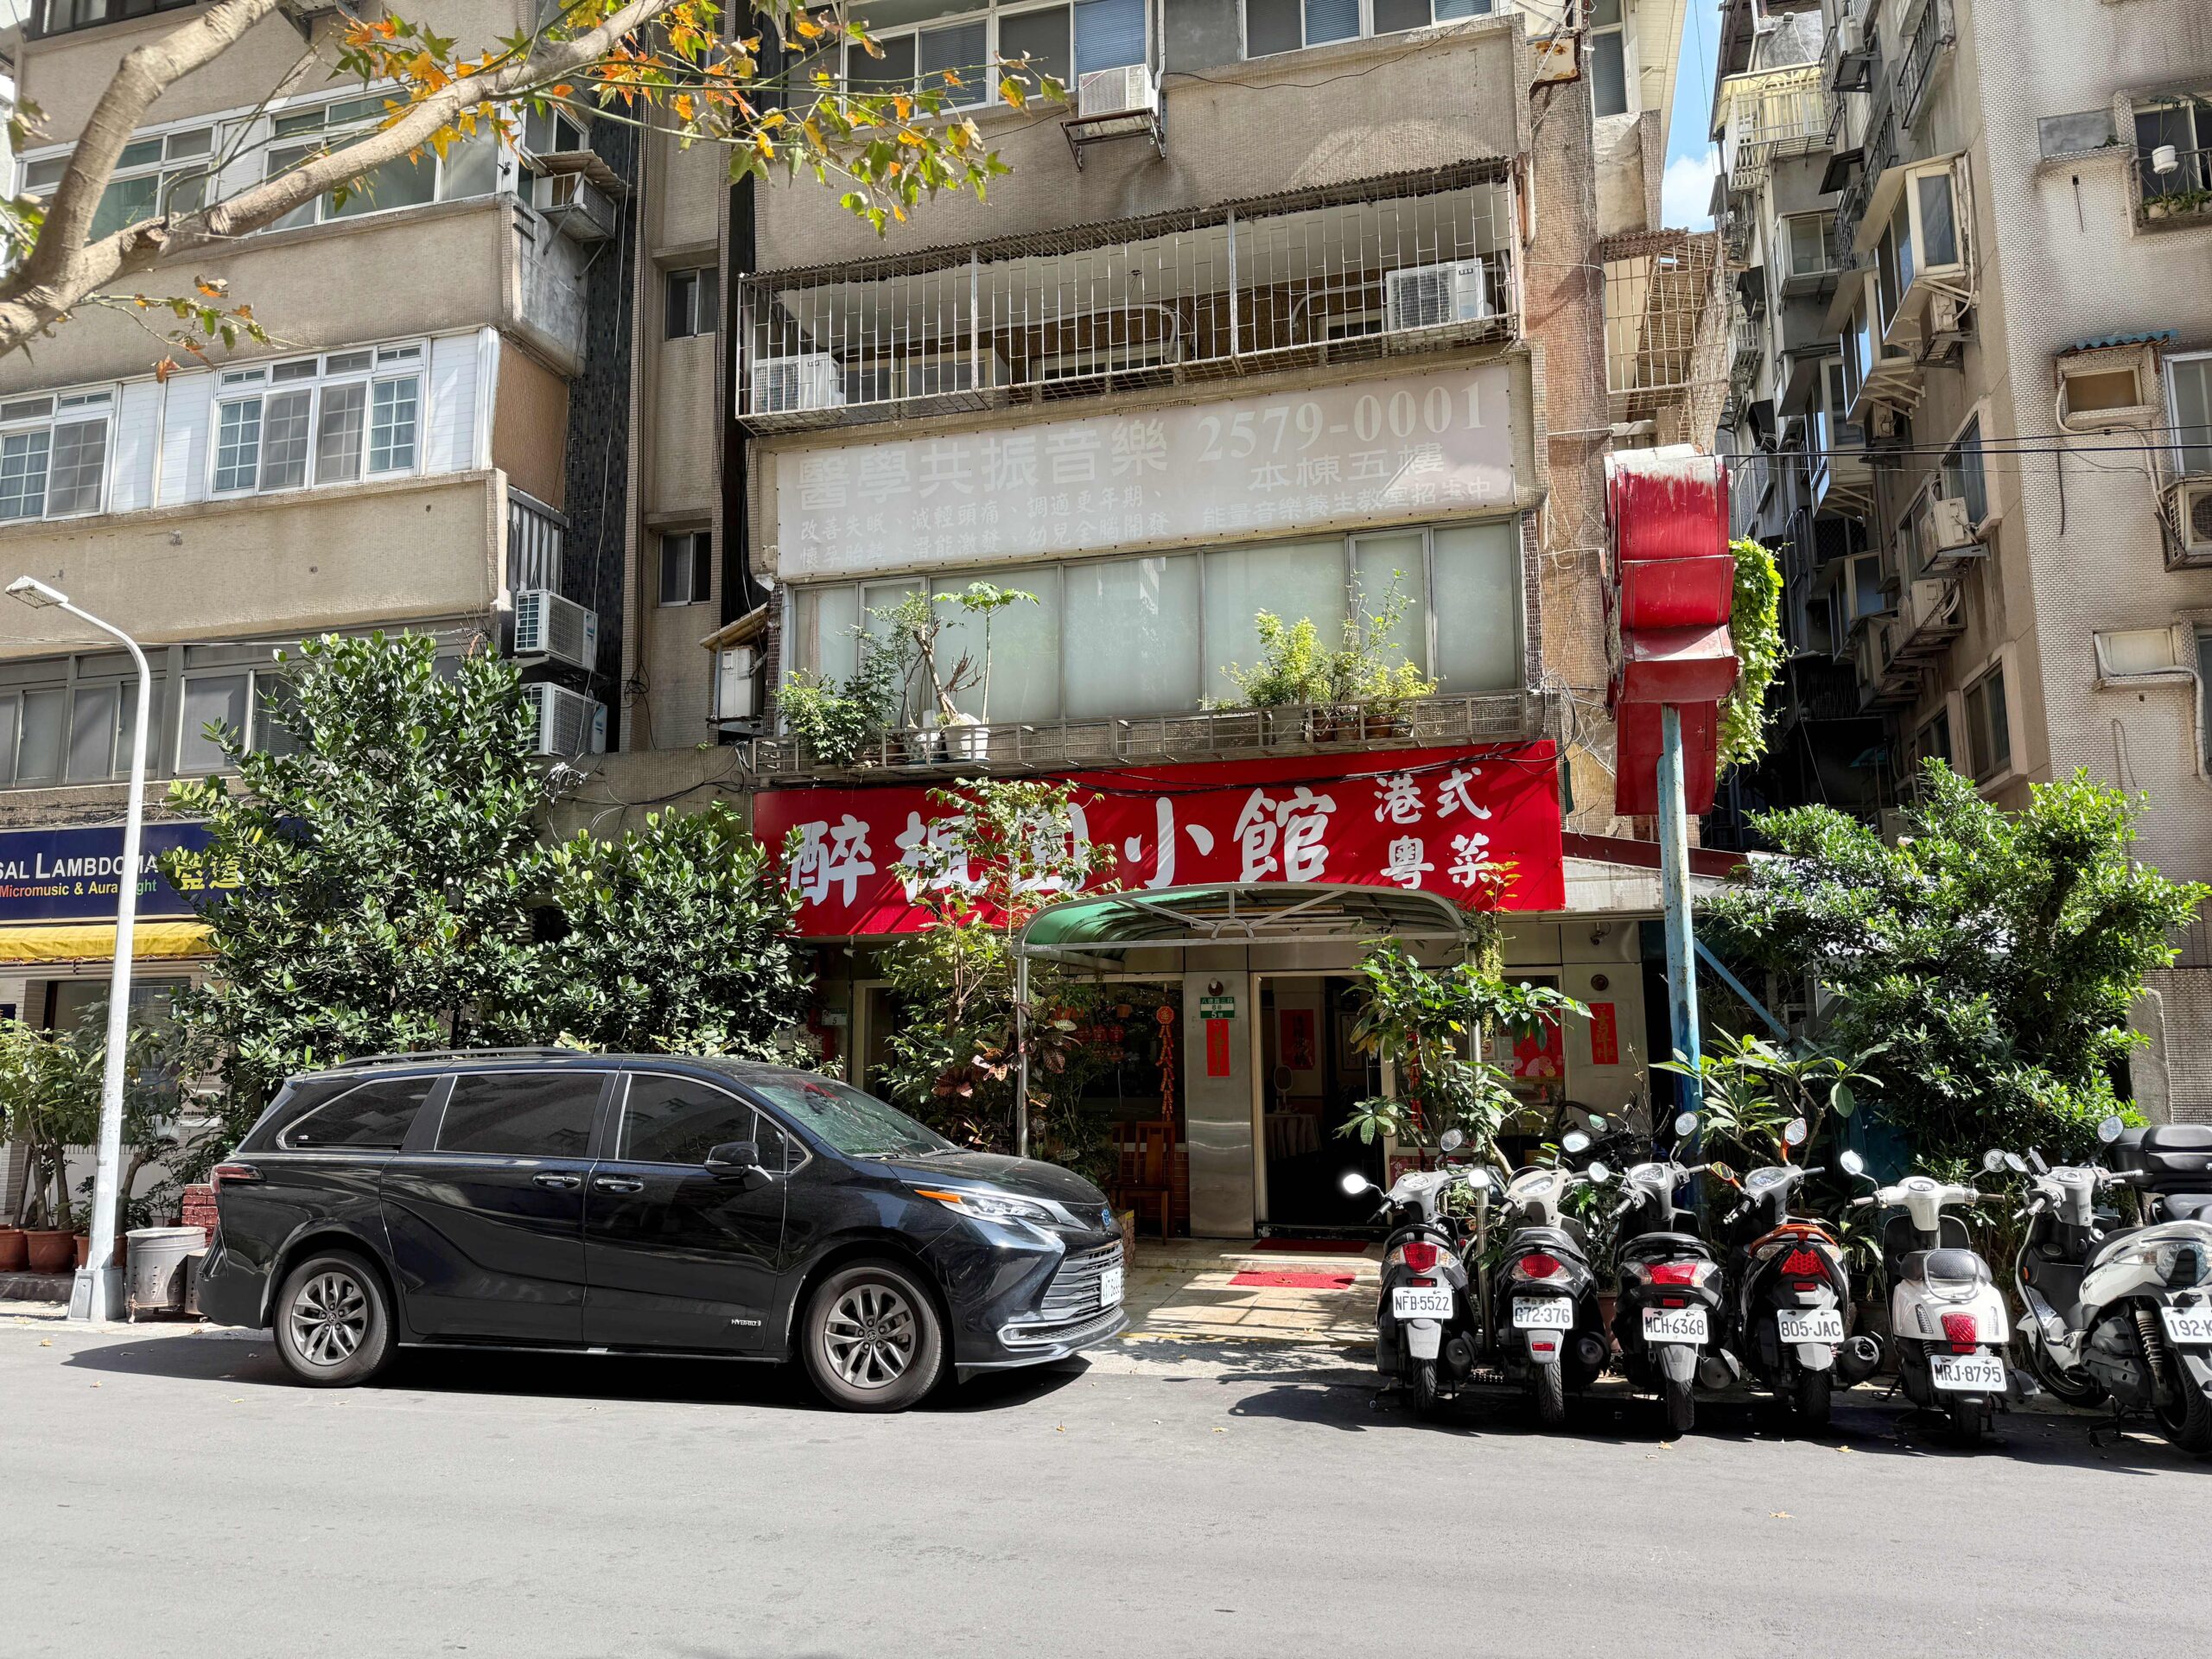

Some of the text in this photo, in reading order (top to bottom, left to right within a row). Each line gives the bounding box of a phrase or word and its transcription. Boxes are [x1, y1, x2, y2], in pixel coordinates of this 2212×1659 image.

[1198, 381, 1487, 462] 2579-0001
[796, 418, 1168, 511] 醫學共振音樂
[1247, 442, 1445, 492] 本棟五樓
[1374, 767, 1492, 824] 港式
[0, 882, 69, 898] Micromusic
[74, 881, 84, 895] &
[88, 880, 118, 894] Aura
[35, 852, 159, 880] LAMBDOA
